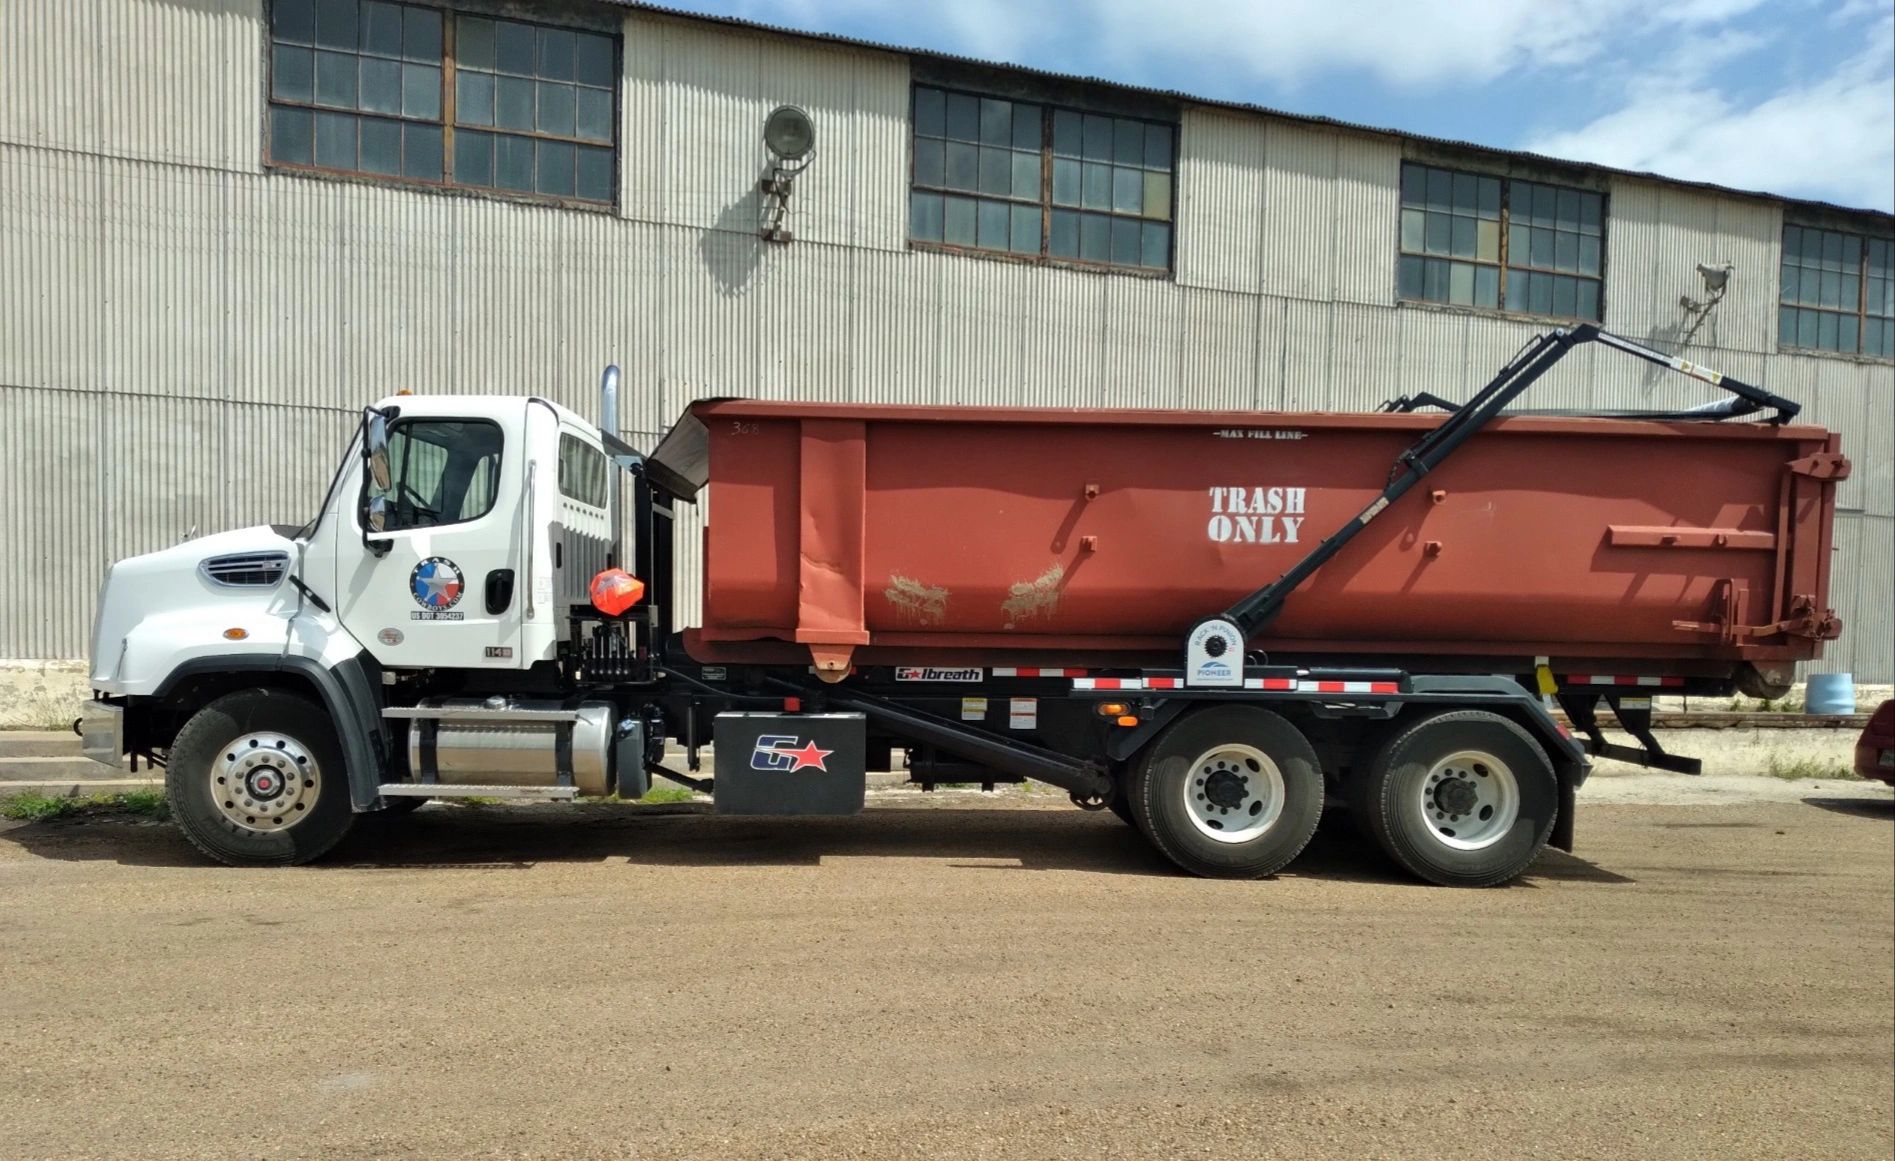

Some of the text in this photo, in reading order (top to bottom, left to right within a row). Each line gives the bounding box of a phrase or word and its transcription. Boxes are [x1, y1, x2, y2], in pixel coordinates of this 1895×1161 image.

[731, 421, 760, 436] 368
[1247, 430, 1273, 439] FILL
[1208, 486, 1306, 514] TRASH
[1207, 515, 1305, 543] ONLY
[412, 557, 462, 574] TRASH
[411, 612, 421, 620] US
[421, 612, 435, 620] DOT
[1194, 629, 1209, 646] RACK
[1196, 669, 1232, 677] PIONEER
